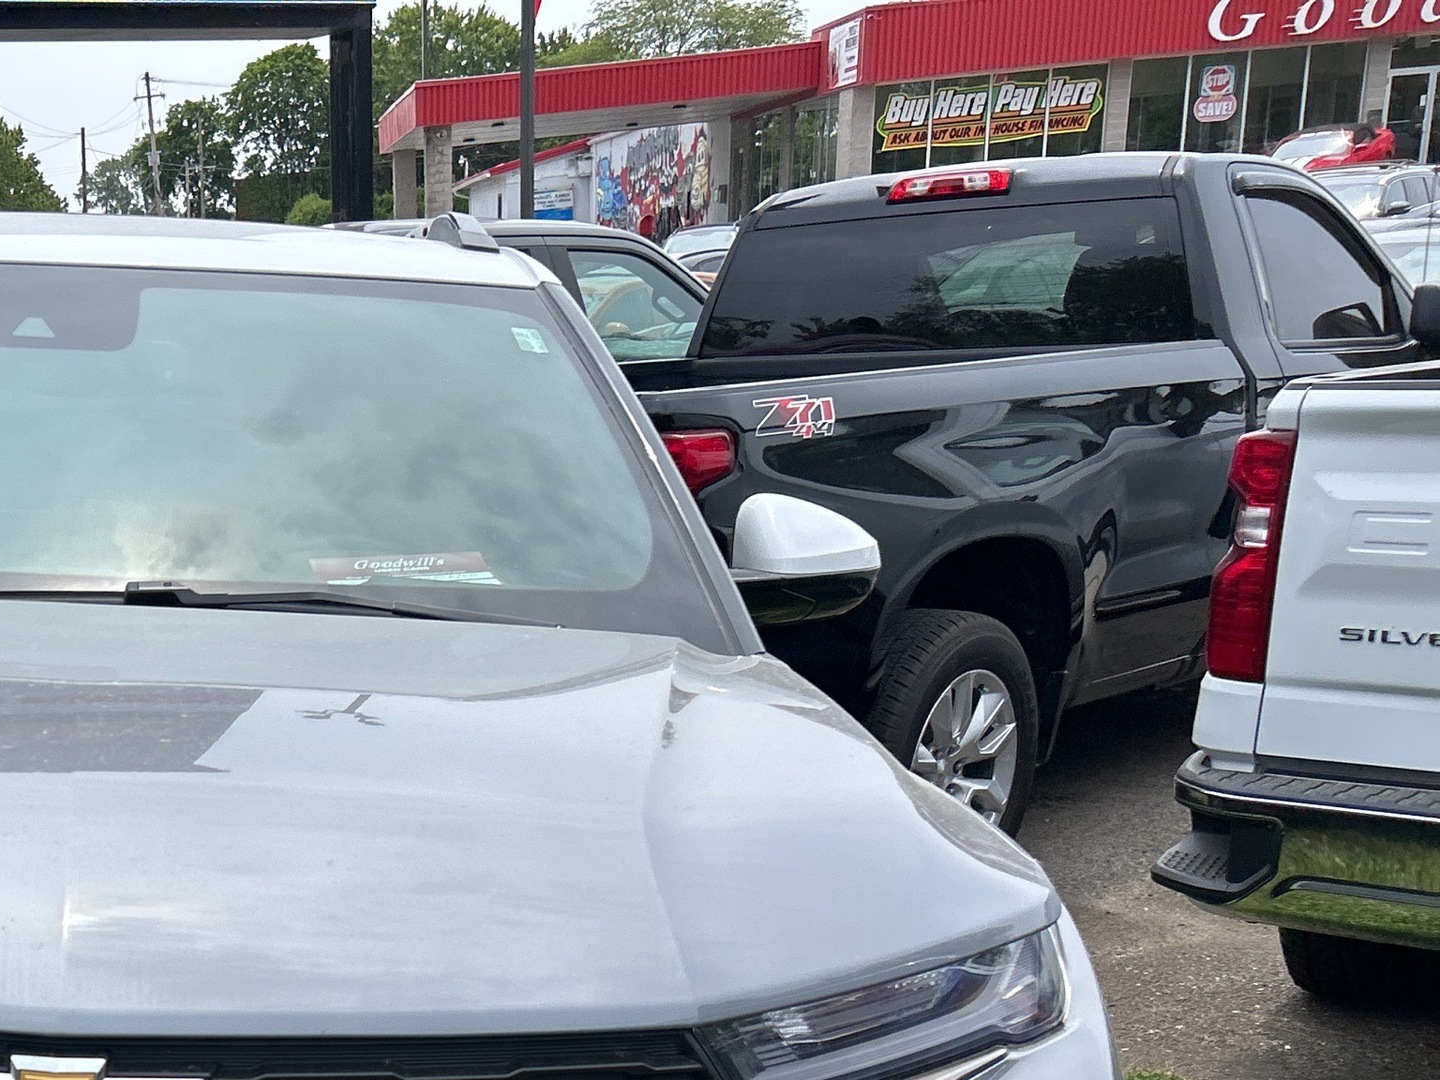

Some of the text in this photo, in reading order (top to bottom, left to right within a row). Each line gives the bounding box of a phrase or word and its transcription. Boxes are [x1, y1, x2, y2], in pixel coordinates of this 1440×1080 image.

[1206, 73, 1230, 88] STOP
[884, 78, 1098, 127] Buy Here Pay Here
[1198, 101, 1233, 117] SAVE!
[890, 131, 911, 145] ASK
[949, 125, 972, 139] OUR
[752, 395, 835, 436] Z71
[354, 557, 444, 570] Goodwill's
